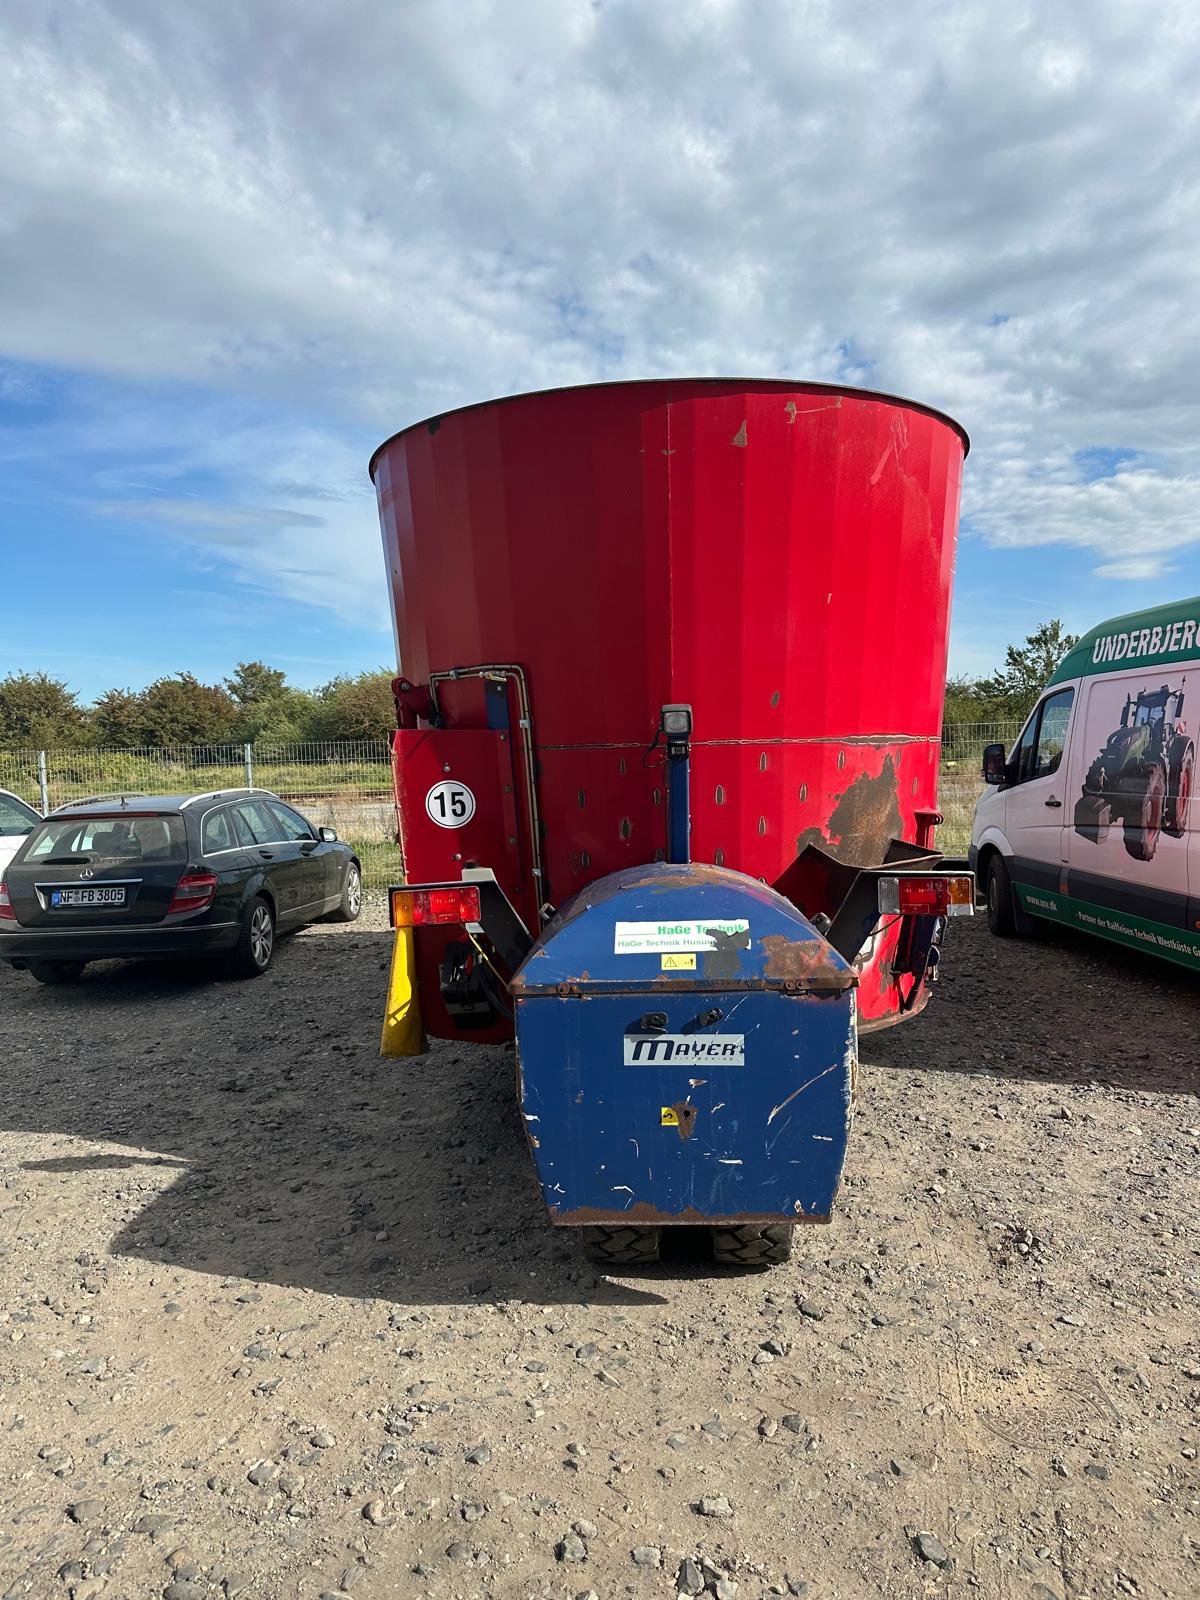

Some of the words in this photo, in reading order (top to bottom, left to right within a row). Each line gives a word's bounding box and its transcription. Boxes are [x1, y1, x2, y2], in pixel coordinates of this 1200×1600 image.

[433, 791, 467, 818] 15
[60, 891, 73, 903] NF
[81, 890, 95, 902] FB
[97, 889, 124, 902] 3805
[657, 926, 691, 935] HaGe
[696, 924, 745, 935] Tehnik
[1134, 928, 1158, 943] Technik
[617, 940, 643, 948] HaGe
[646, 939, 680, 947] Technik
[631, 1040, 736, 1061] MAYER
